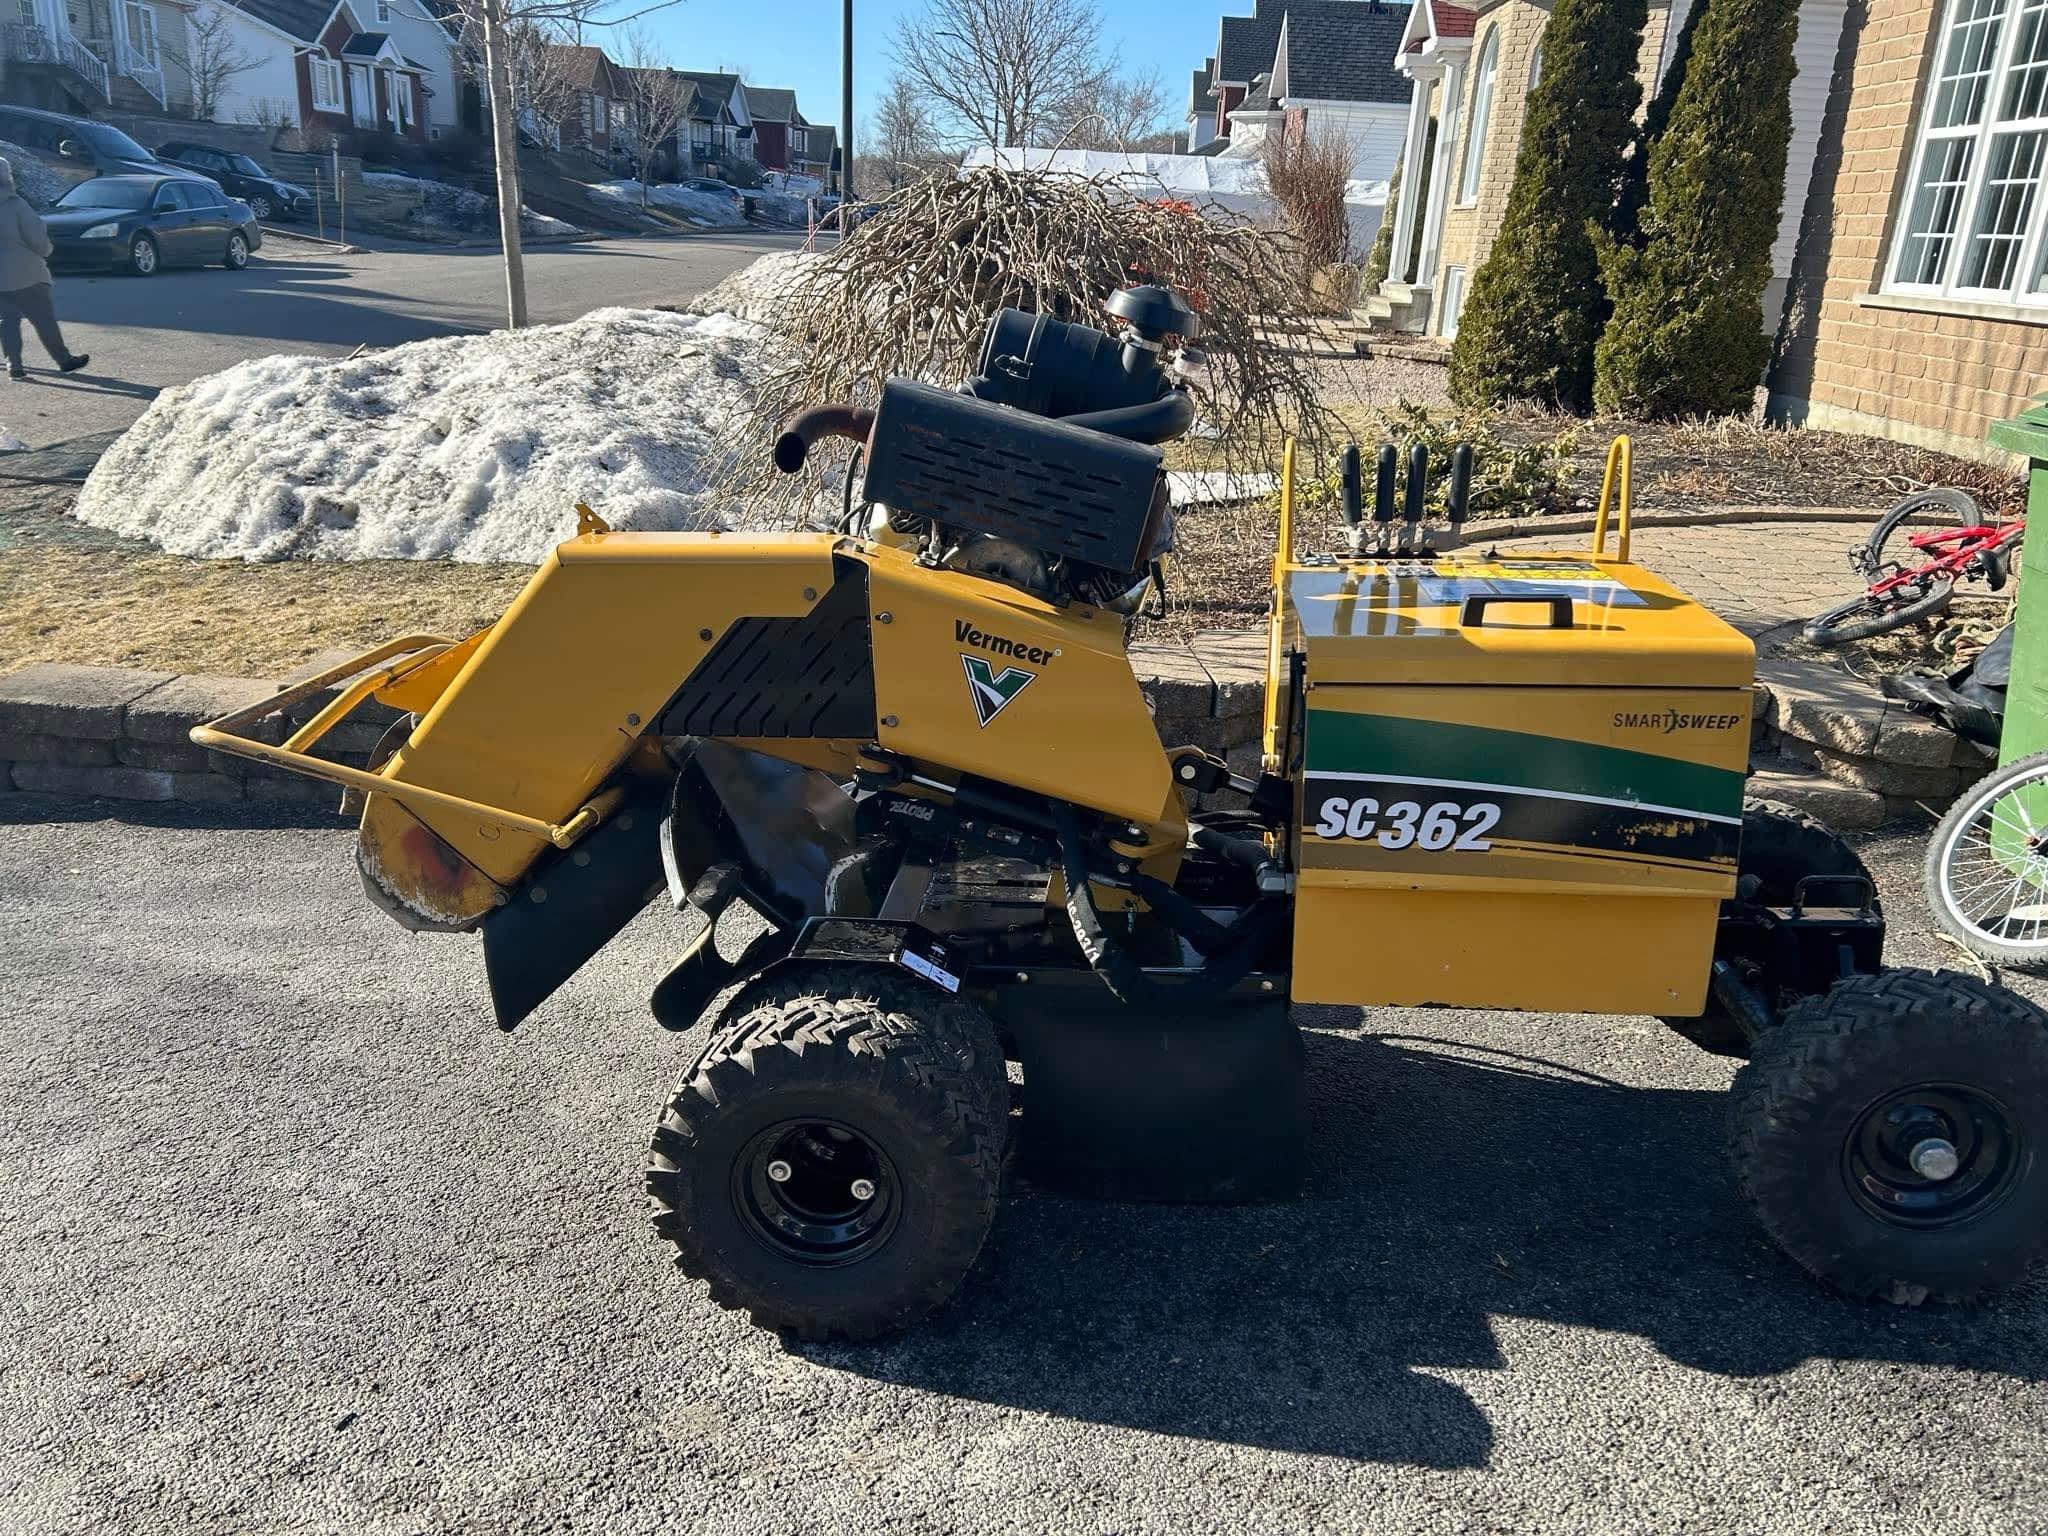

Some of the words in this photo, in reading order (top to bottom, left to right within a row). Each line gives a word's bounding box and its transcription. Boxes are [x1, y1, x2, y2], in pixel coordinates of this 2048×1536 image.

[955, 619, 1054, 667] Vermeer
[1613, 713, 1670, 728] SMART
[1678, 714, 1741, 730] SWEEP
